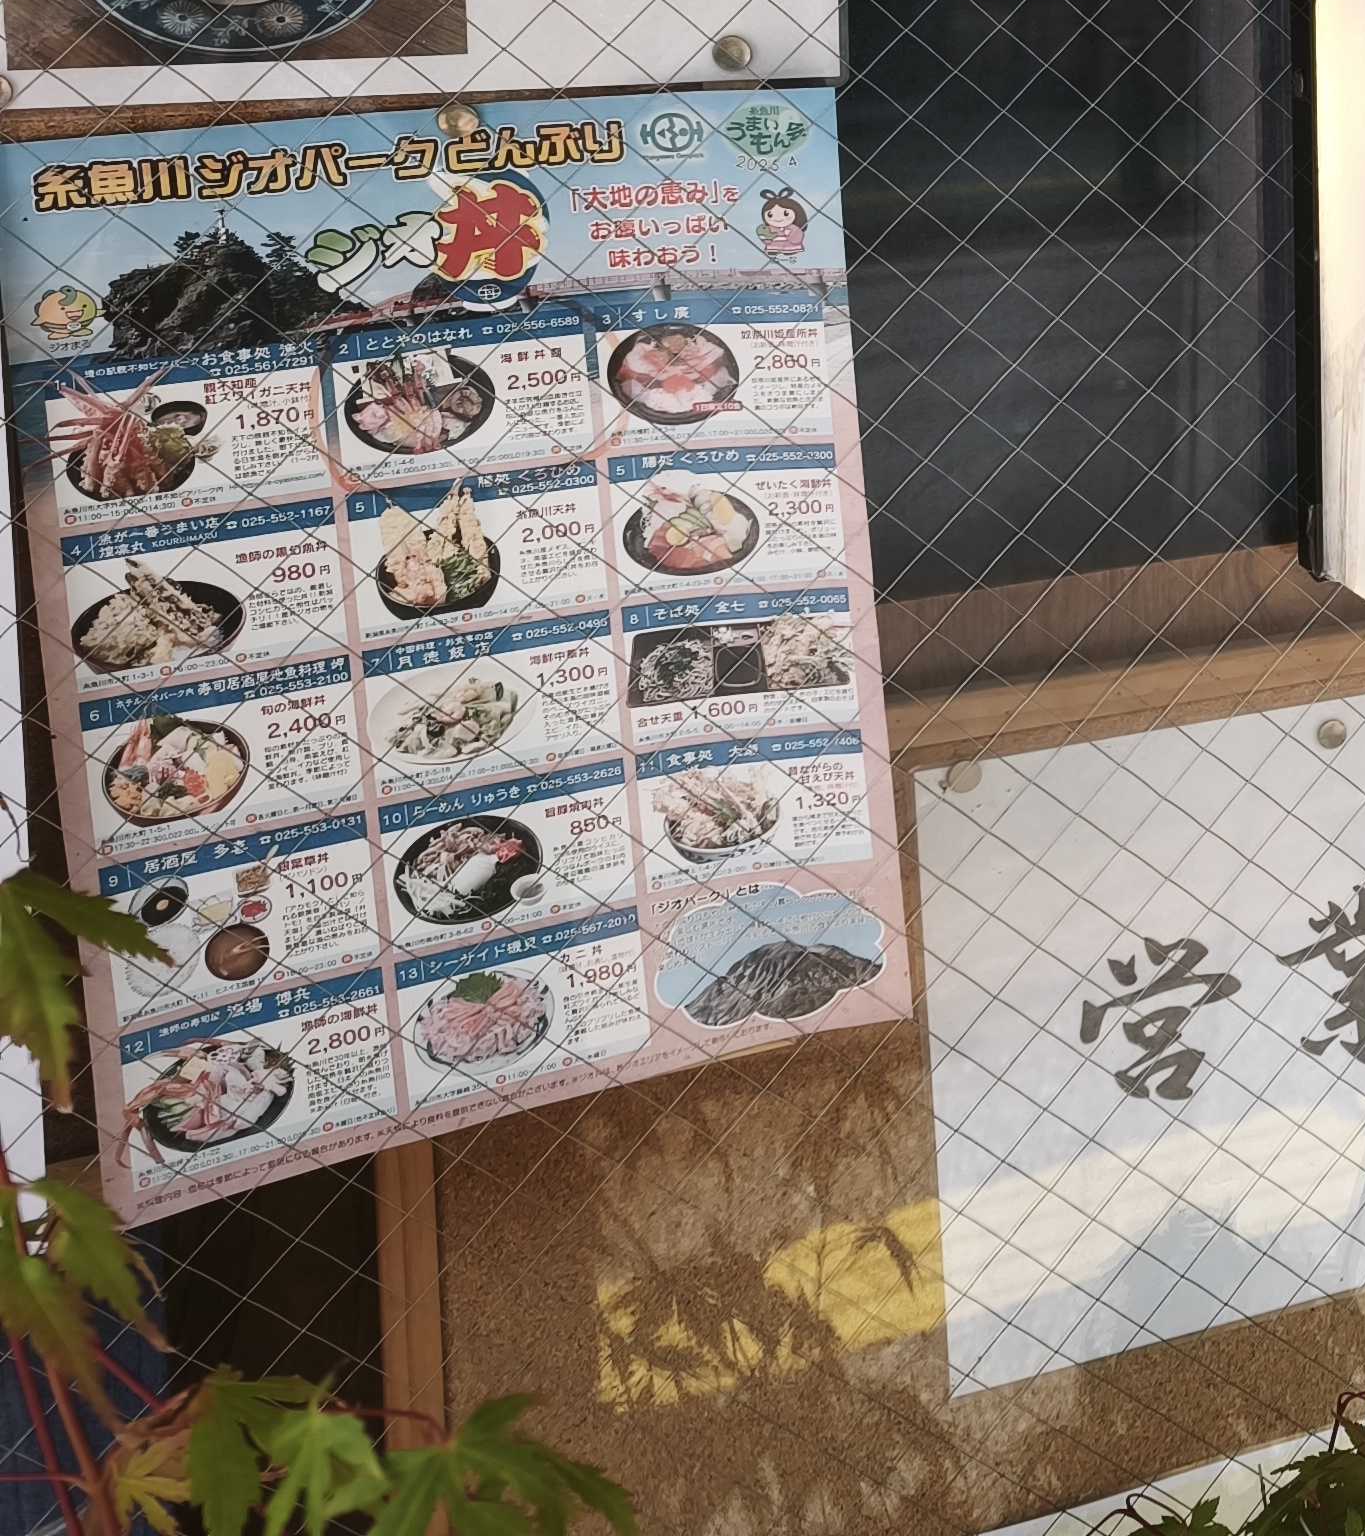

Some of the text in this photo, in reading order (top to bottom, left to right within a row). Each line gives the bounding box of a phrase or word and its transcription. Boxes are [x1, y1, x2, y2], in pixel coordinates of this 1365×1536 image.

[602, 314, 611, 325] 3
[338, 344, 350, 355] 2
[366, 327, 473, 351] ととやのはなれ
[224, 355, 315, 376] 025-561-7291
[615, 465, 625, 476] 5
[680, 449, 740, 464] くろひめ
[355, 502, 365, 513] 5
[70, 547, 82, 557] 4
[241, 505, 331, 528] 025-552-1167
[259, 670, 350, 697] 025-553-2100
[89, 710, 101, 722] 6
[382, 814, 402, 826] 10
[107, 875, 118, 887] 9
[399, 969, 418, 981] 13
[124, 1040, 144, 1053] 12
